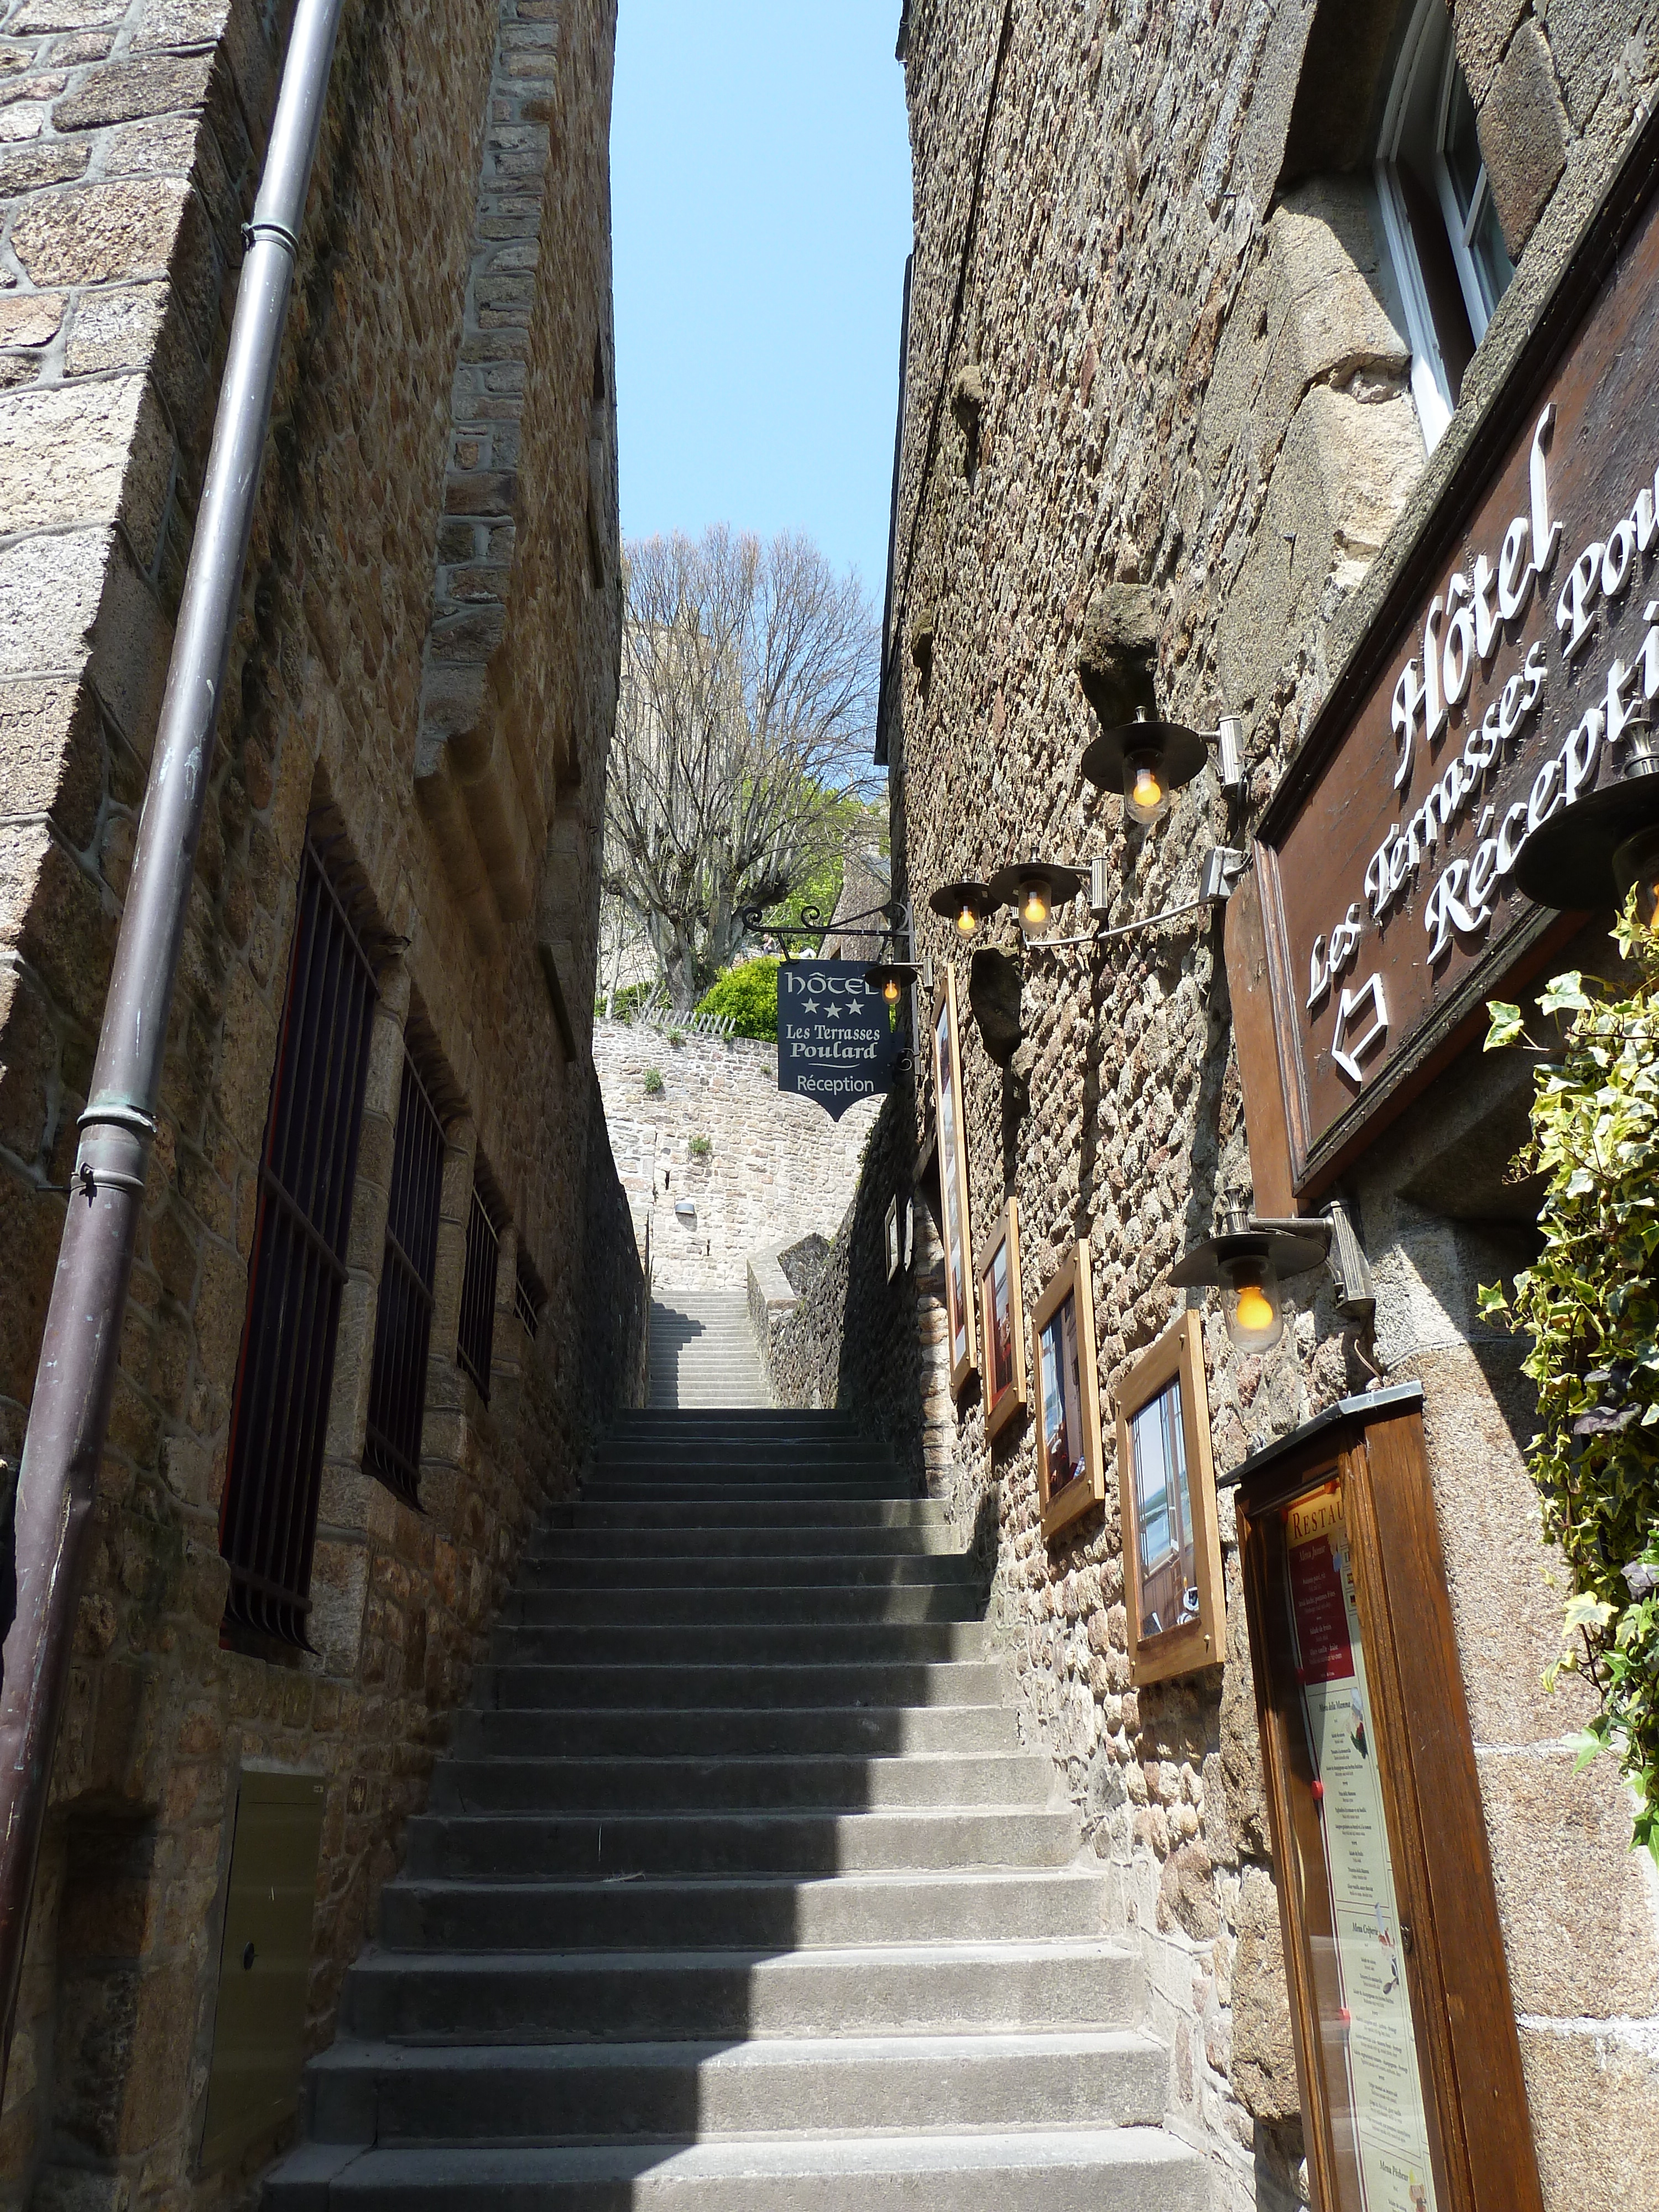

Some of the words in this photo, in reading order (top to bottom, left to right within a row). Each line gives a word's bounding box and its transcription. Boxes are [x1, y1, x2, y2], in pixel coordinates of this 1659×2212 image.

[1391, 402, 1563, 789] Hôtel
[1307, 902, 1360, 1009] Les
[1365, 641, 1547, 918] Terrasses
[786, 1024, 810, 1039] Les
[814, 1025, 880, 1041] Terrasses
[790, 1041, 878, 1059] Poulard
[797, 1074, 874, 1095] Réception
[1353, 1922, 1363, 1933] Menu
[1379, 2160, 1392, 2174] Menu
